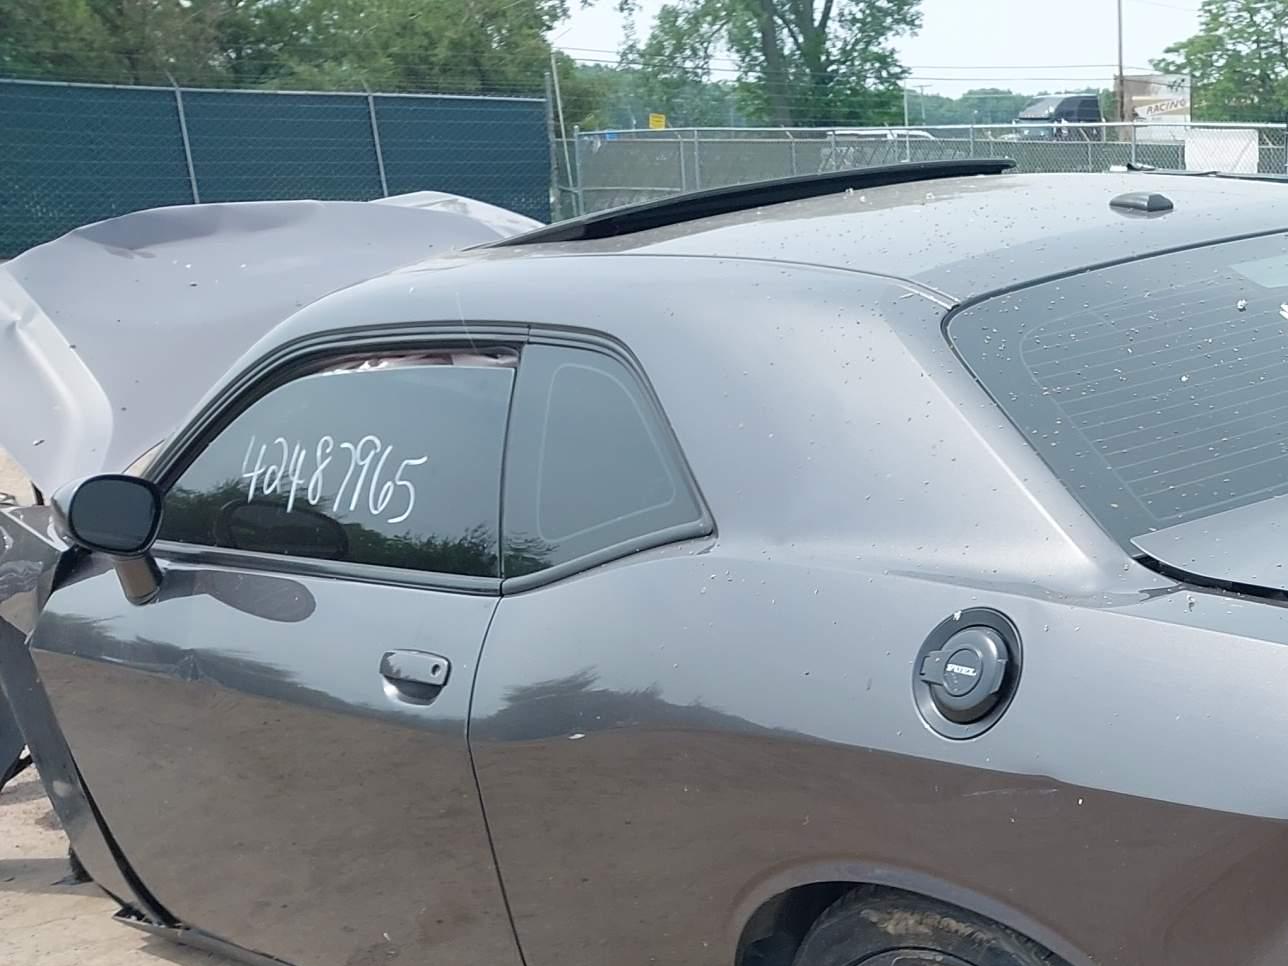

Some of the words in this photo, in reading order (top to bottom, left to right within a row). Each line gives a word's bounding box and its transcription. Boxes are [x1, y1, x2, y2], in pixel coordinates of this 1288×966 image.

[1146, 99, 1187, 115] RACING
[242, 435, 428, 523] 42487965
[946, 663, 977, 676] FUEL
